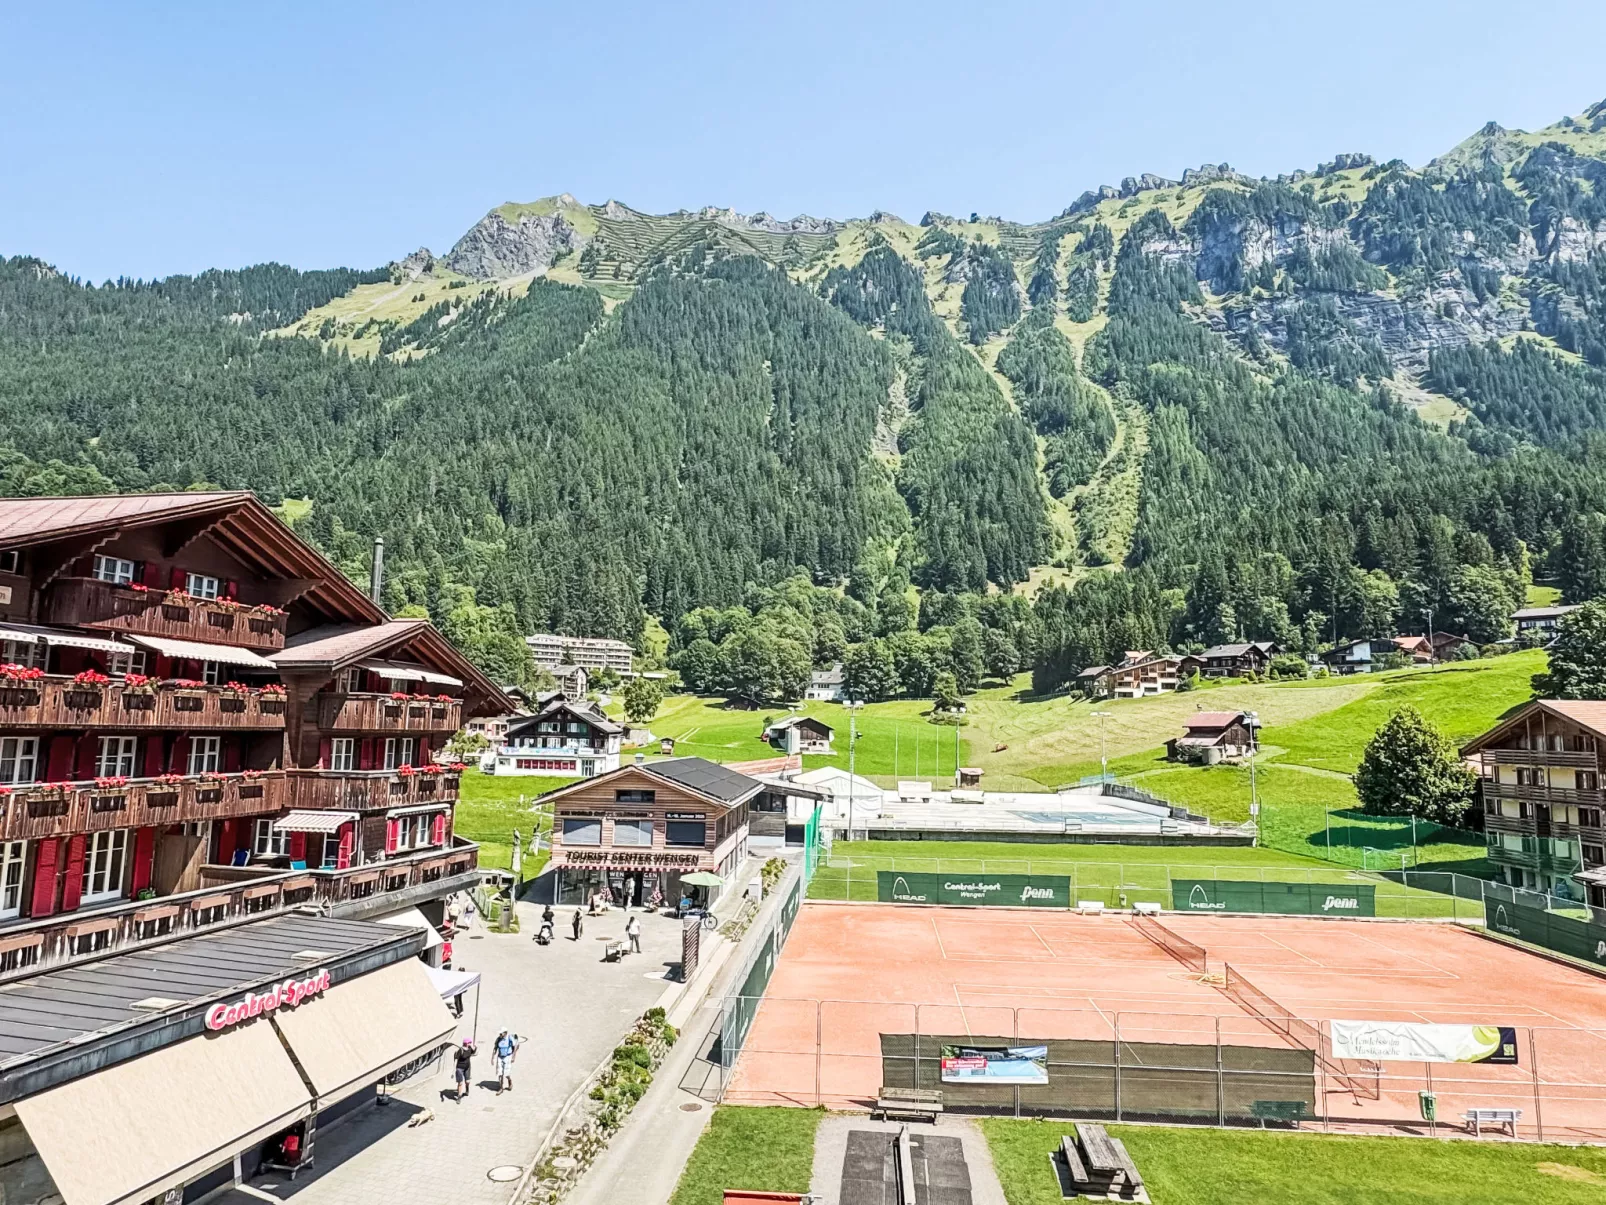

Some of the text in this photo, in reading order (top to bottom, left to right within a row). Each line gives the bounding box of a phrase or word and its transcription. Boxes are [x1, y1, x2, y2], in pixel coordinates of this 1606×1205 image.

[567, 851, 699, 865] TOURIST CENTER WENGEN
[960, 891, 986, 899] Wengen
[1496, 924, 1520, 935] HEAD
